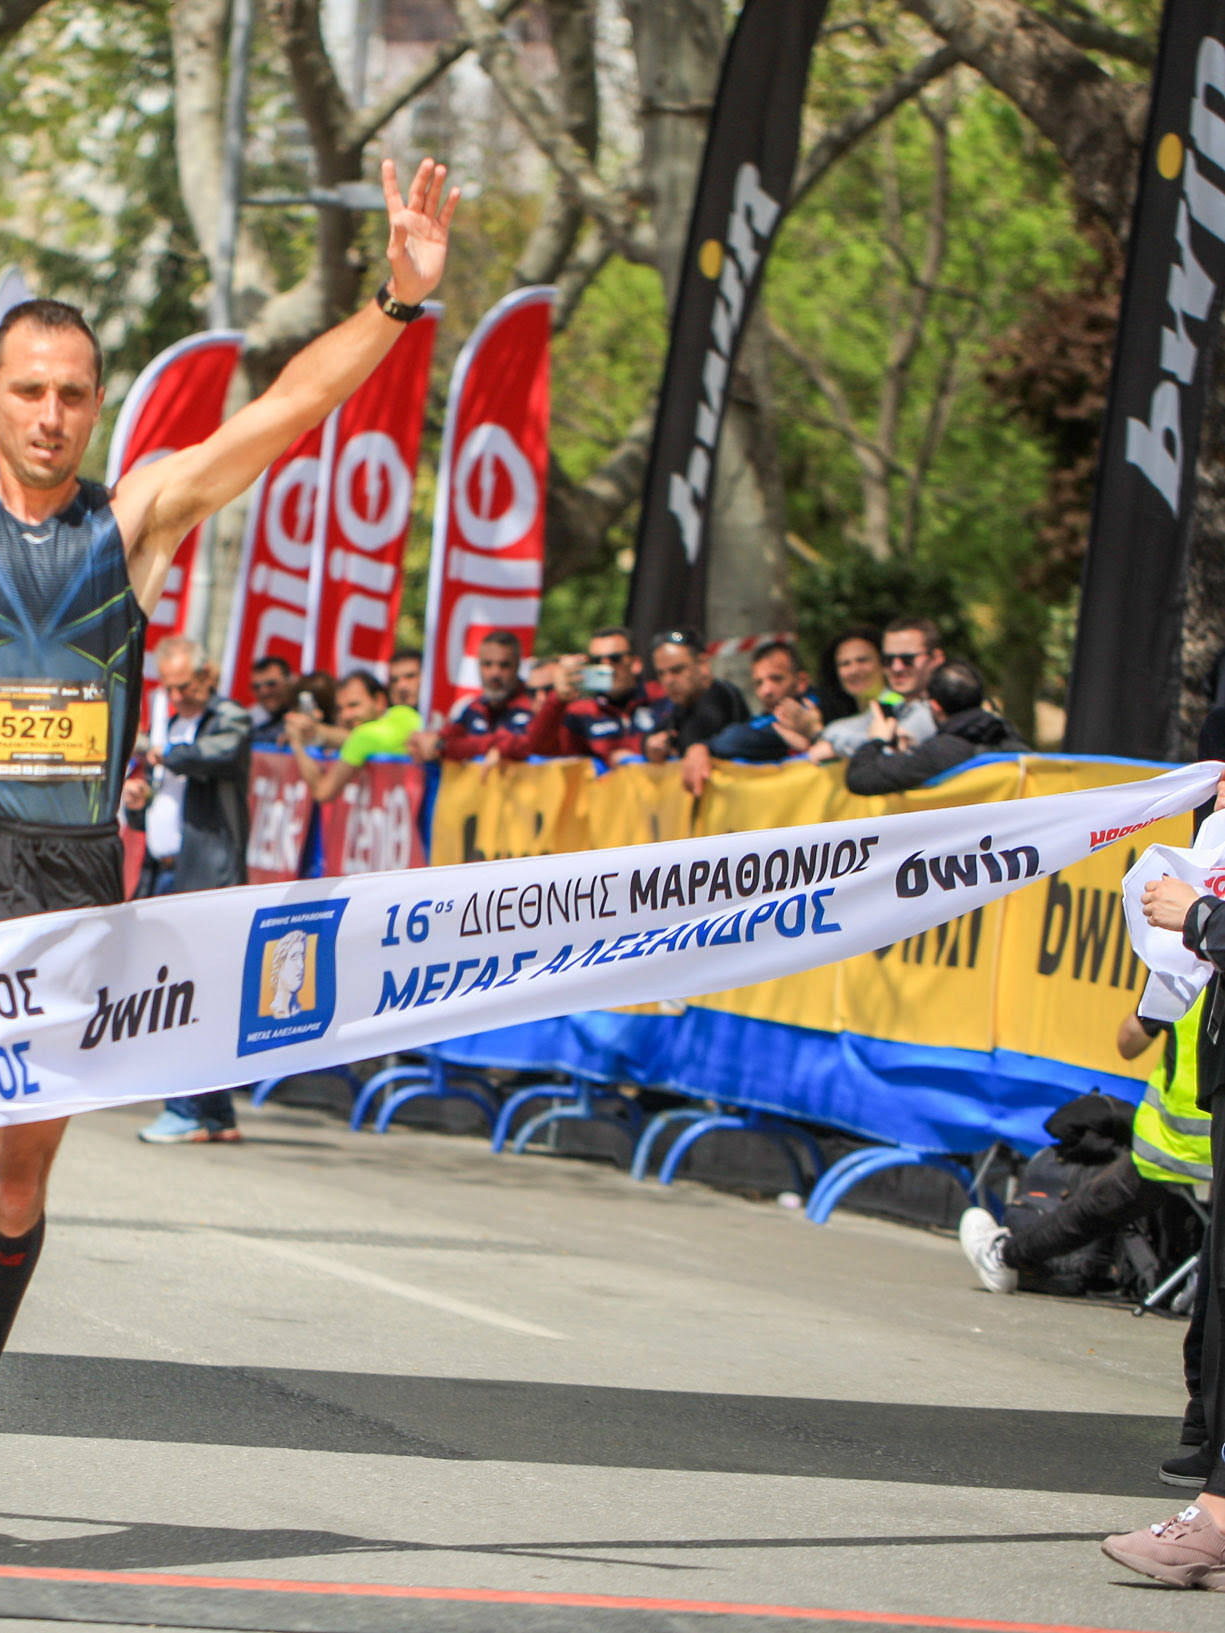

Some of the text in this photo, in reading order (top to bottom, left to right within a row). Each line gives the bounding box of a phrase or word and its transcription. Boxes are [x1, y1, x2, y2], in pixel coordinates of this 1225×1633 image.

[1125, 35, 1225, 520] bwin
[668, 162, 782, 566] bwin
[0, 716, 74, 739] 5279
[460, 872, 619, 937] ΔΙΕΘΝΗΣ
[630, 835, 880, 914] ΜΑΡΑΘΩΝΙΟΣ
[895, 834, 1040, 899] bwin
[1037, 847, 1141, 991] bwi
[79, 964, 196, 1050] bwin
[373, 949, 539, 1017] ΜΕΓΑΣ
[528, 887, 842, 981] ΑΛΕΞΑΝΔΡΟΣ
